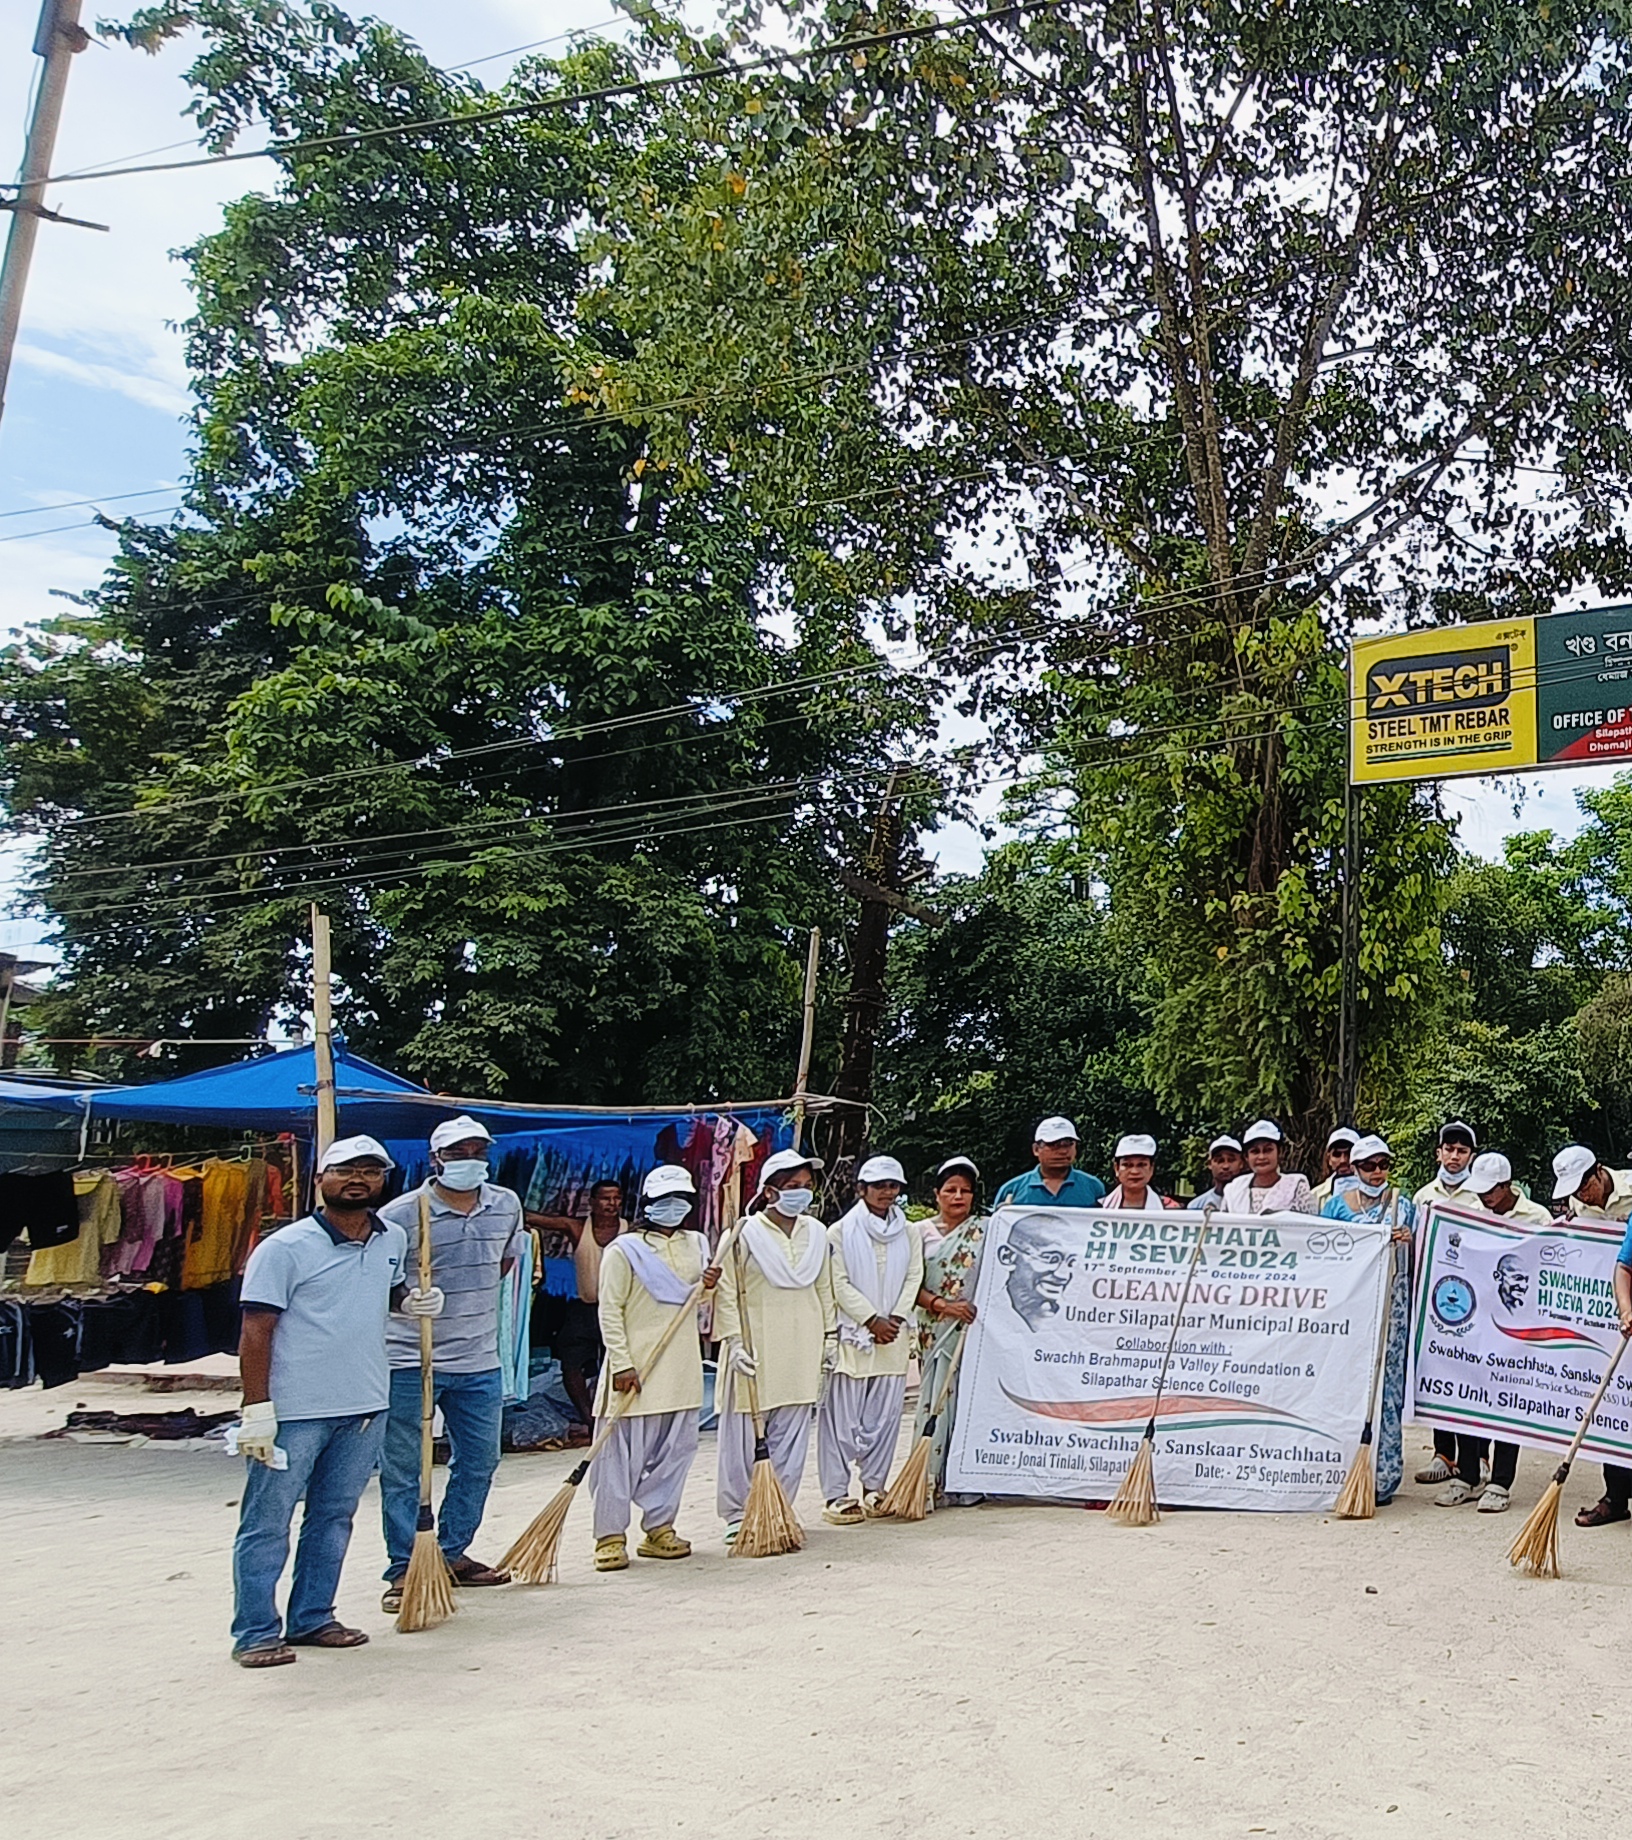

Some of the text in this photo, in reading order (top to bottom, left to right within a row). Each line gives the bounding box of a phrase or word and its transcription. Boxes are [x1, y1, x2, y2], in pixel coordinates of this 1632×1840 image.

[1371, 661, 1502, 709] XTECH
[1368, 708, 1510, 740] STEEL TMT REBAR
[1553, 710, 1603, 730] OFFICE
[1606, 708, 1626, 725] OF
[1366, 730, 1512, 754] STRENGTH IS IN THE GRIP
[1589, 739, 1632, 753] Dhemaji
[1090, 1220, 1281, 1248] SWACHHATA
[1084, 1241, 1299, 1269] HI SEVA 2024
[1108, 1263, 1178, 1277] September
[1211, 1270, 1261, 1281] October
[1264, 1272, 1297, 1282] 2024
[1538, 1269, 1614, 1299] SWACHHATA
[1092, 1278, 1328, 1310] CLEANING DRIVE
[1538, 1289, 1553, 1307] HI
[1556, 1291, 1583, 1314] SEVA
[1065, 1305, 1116, 1325] Under
[1208, 1314, 1294, 1336] Municipal
[1299, 1317, 1350, 1336] Board
[1199, 1342, 1227, 1355] with
[1428, 1339, 1483, 1364] Swabhav
[1033, 1349, 1316, 1378] Swachh Brahmaputa Valley Foundation &
[1080, 1371, 1261, 1397] Silapathar Science College
[1490, 1371, 1534, 1387] National
[1535, 1378, 1563, 1393] Service
[1419, 1376, 1454, 1397] NSS
[1458, 1383, 1492, 1408] Unit,
[1497, 1391, 1571, 1420] Silapathar
[1575, 1406, 1629, 1432] Sience
[989, 1427, 1064, 1447] Swabhav
[1165, 1438, 1246, 1459] Sanskaar
[1248, 1443, 1342, 1463] Swachhata
[1017, 1452, 1047, 1469] Jonai
[1258, 1466, 1324, 1487] September,
[1325, 1469, 1347, 1485] 202
